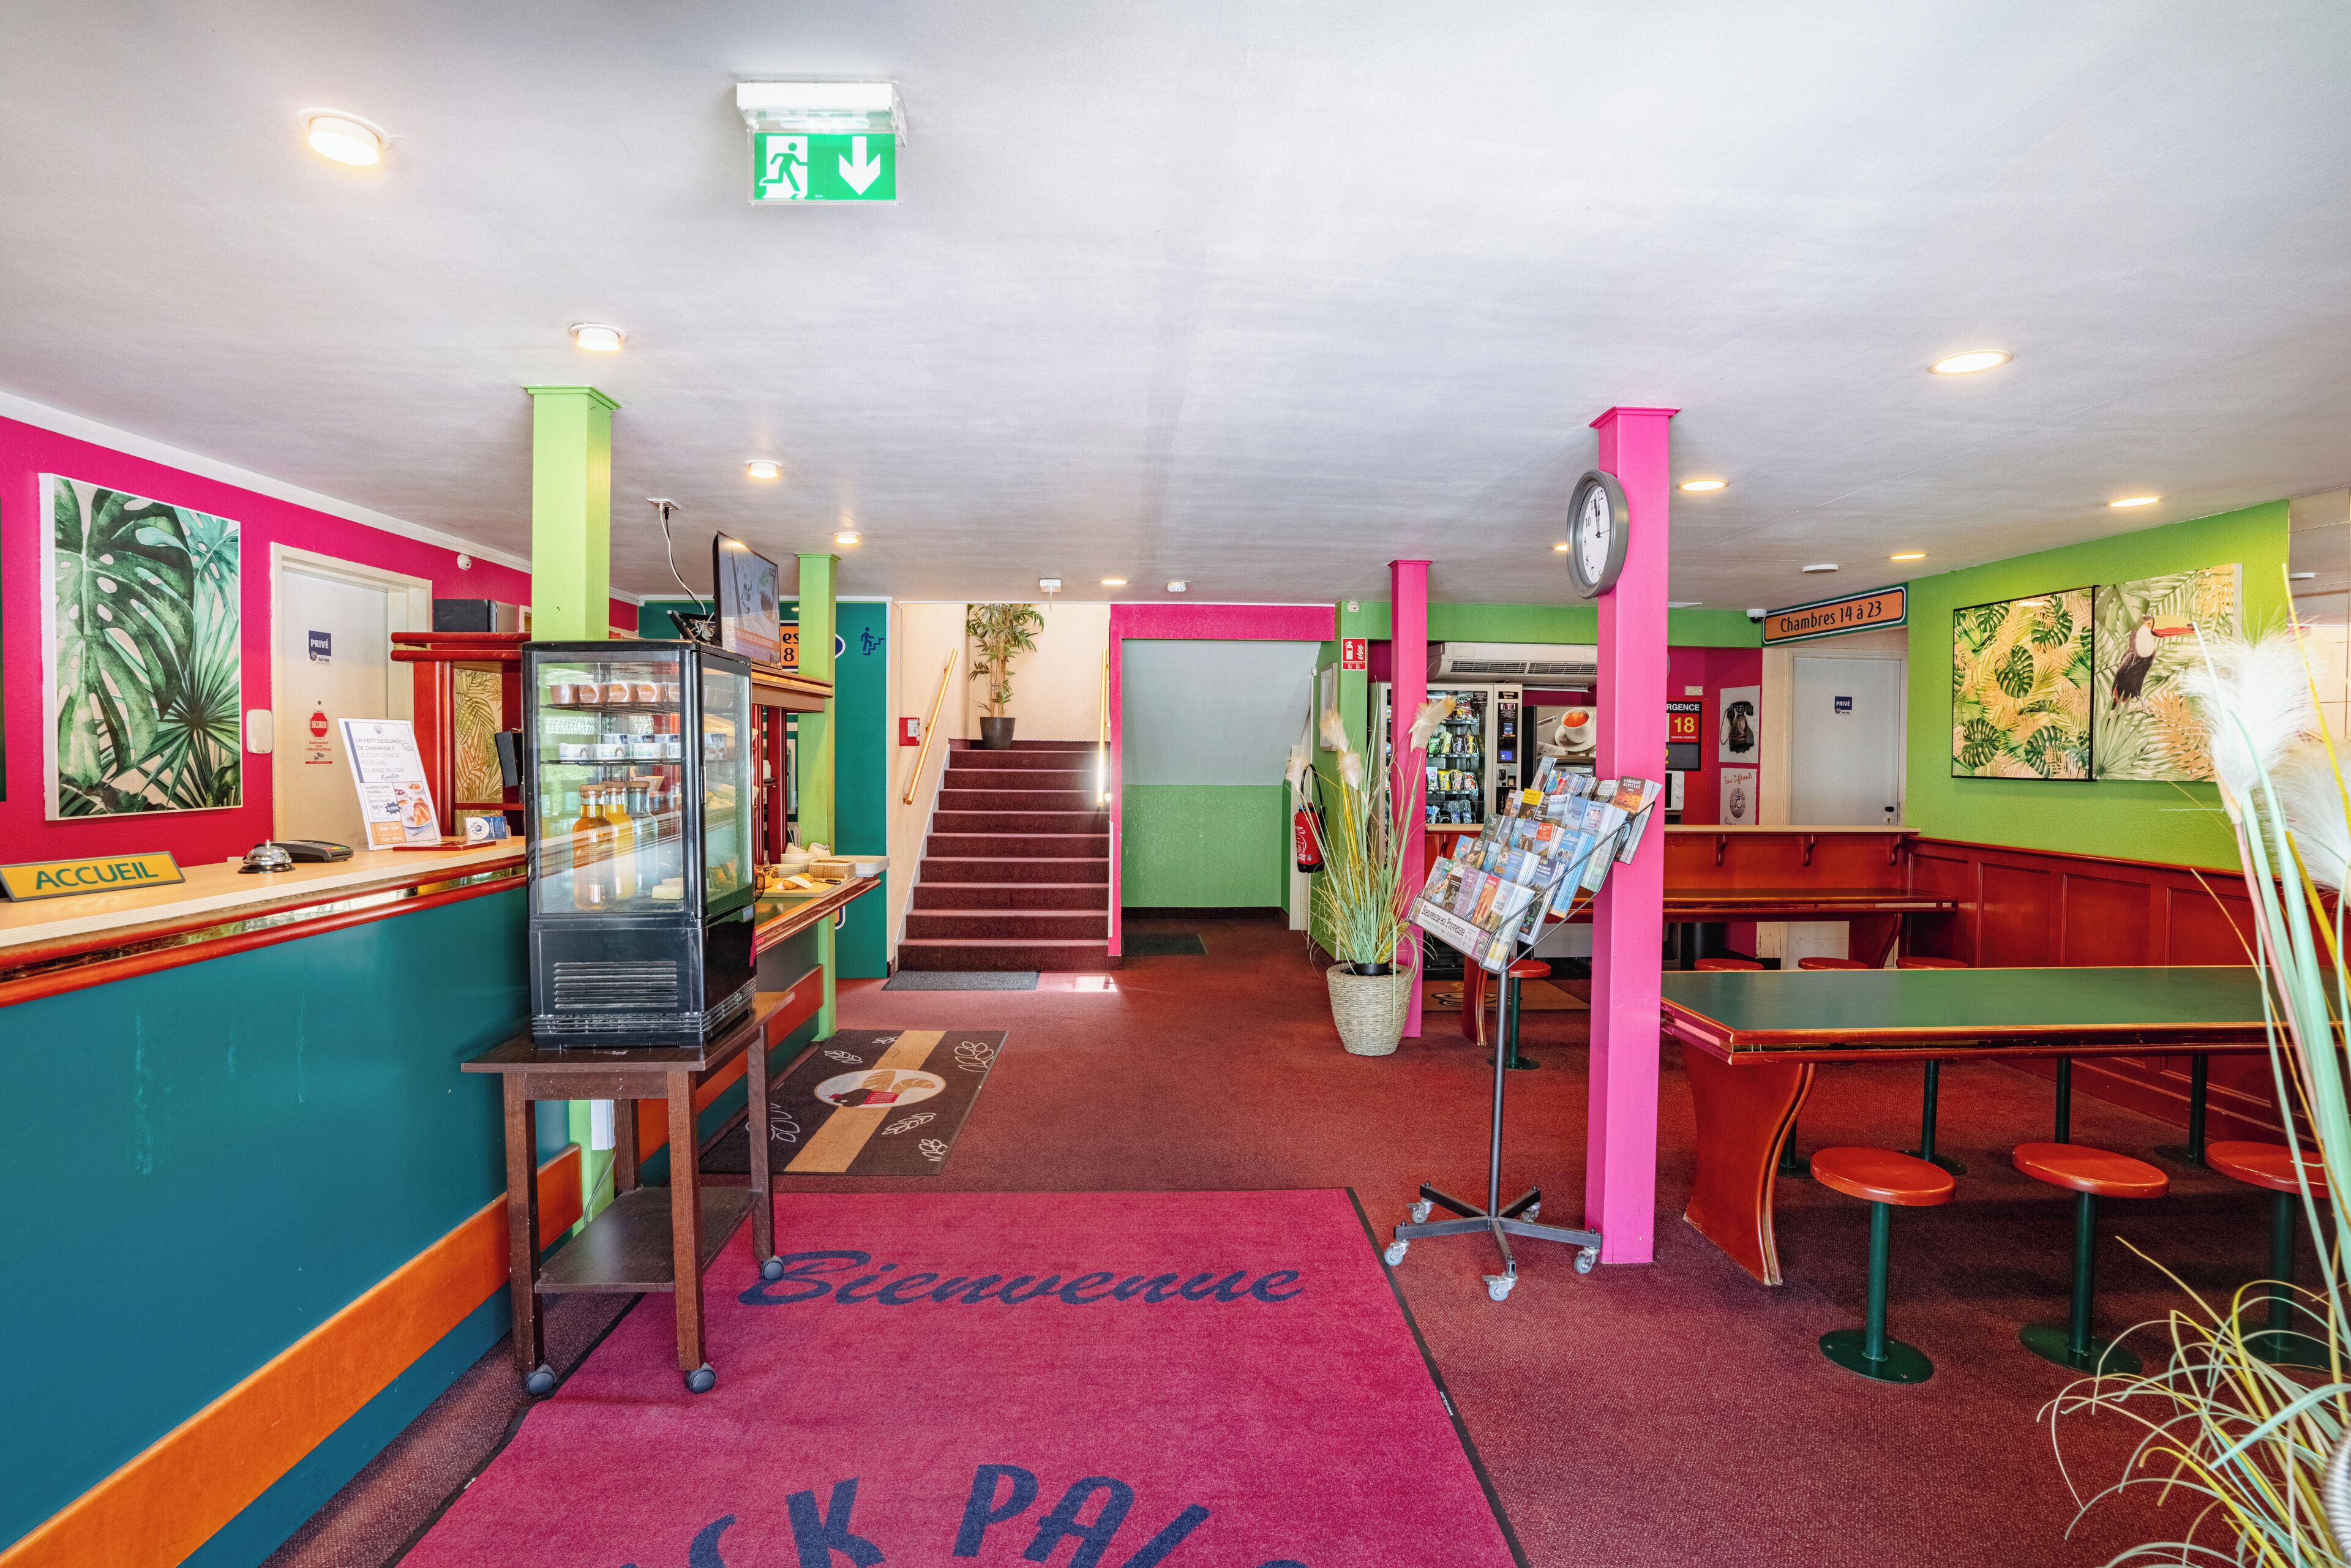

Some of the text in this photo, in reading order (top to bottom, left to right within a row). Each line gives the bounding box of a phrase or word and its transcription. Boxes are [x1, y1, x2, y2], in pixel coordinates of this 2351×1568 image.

[1597, 490, 1603, 502] 12
[1585, 516, 1591, 528] 10
[1583, 536, 1587, 547] 9
[1586, 555, 1589, 566] 8
[1591, 567, 1594, 577] 7
[1780, 601, 1881, 632] Chambres 14 à 23
[310, 639, 329, 649] PRIVÉ
[311, 720, 327, 729] SECUROR
[1674, 717, 1695, 733] 18
[36, 861, 159, 890] ACCUEIL
[1422, 905, 1465, 936] Bienvenue en Provence
[737, 1250, 1304, 1306] Bienvenue
